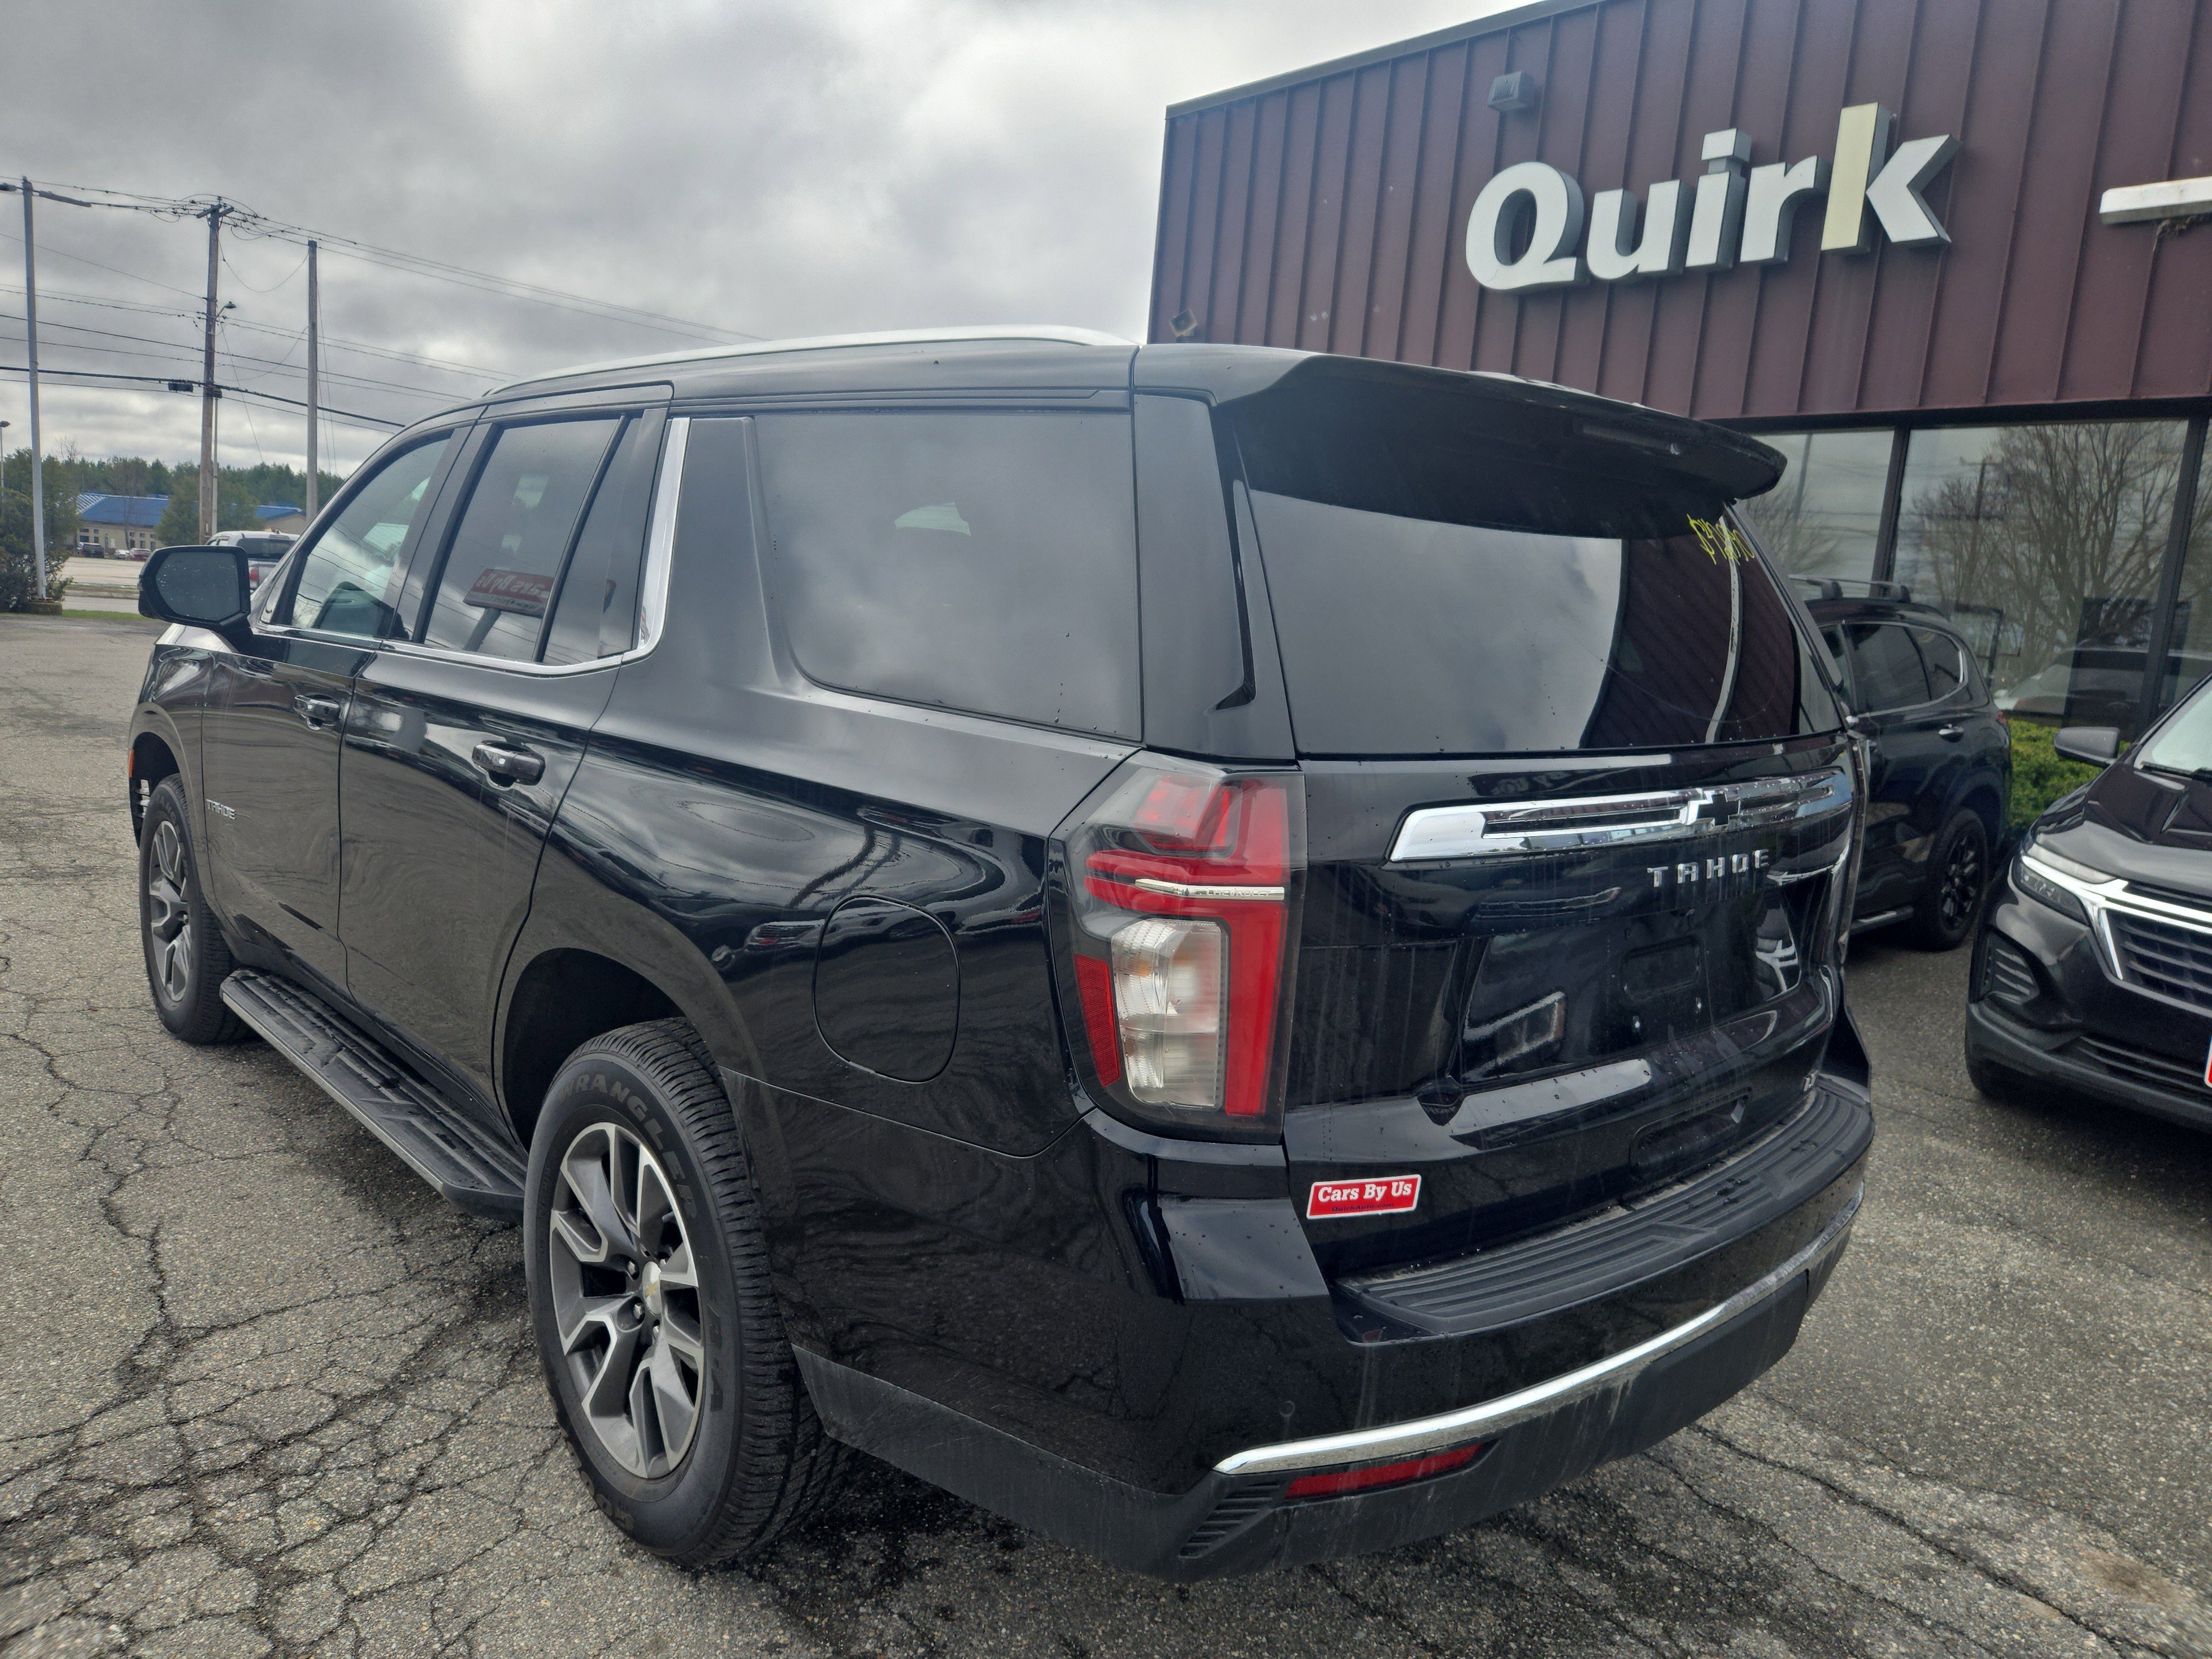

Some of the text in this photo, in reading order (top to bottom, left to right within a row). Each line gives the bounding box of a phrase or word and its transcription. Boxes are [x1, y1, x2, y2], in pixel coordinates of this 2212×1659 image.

[1465, 101, 1956, 291] Quirk
[206, 799, 236, 820] TAHOE
[1647, 848, 1770, 888] TAHOE
[558, 1073, 697, 1219] WRANGLER
[1317, 1181, 1412, 1203] Cars By Us
